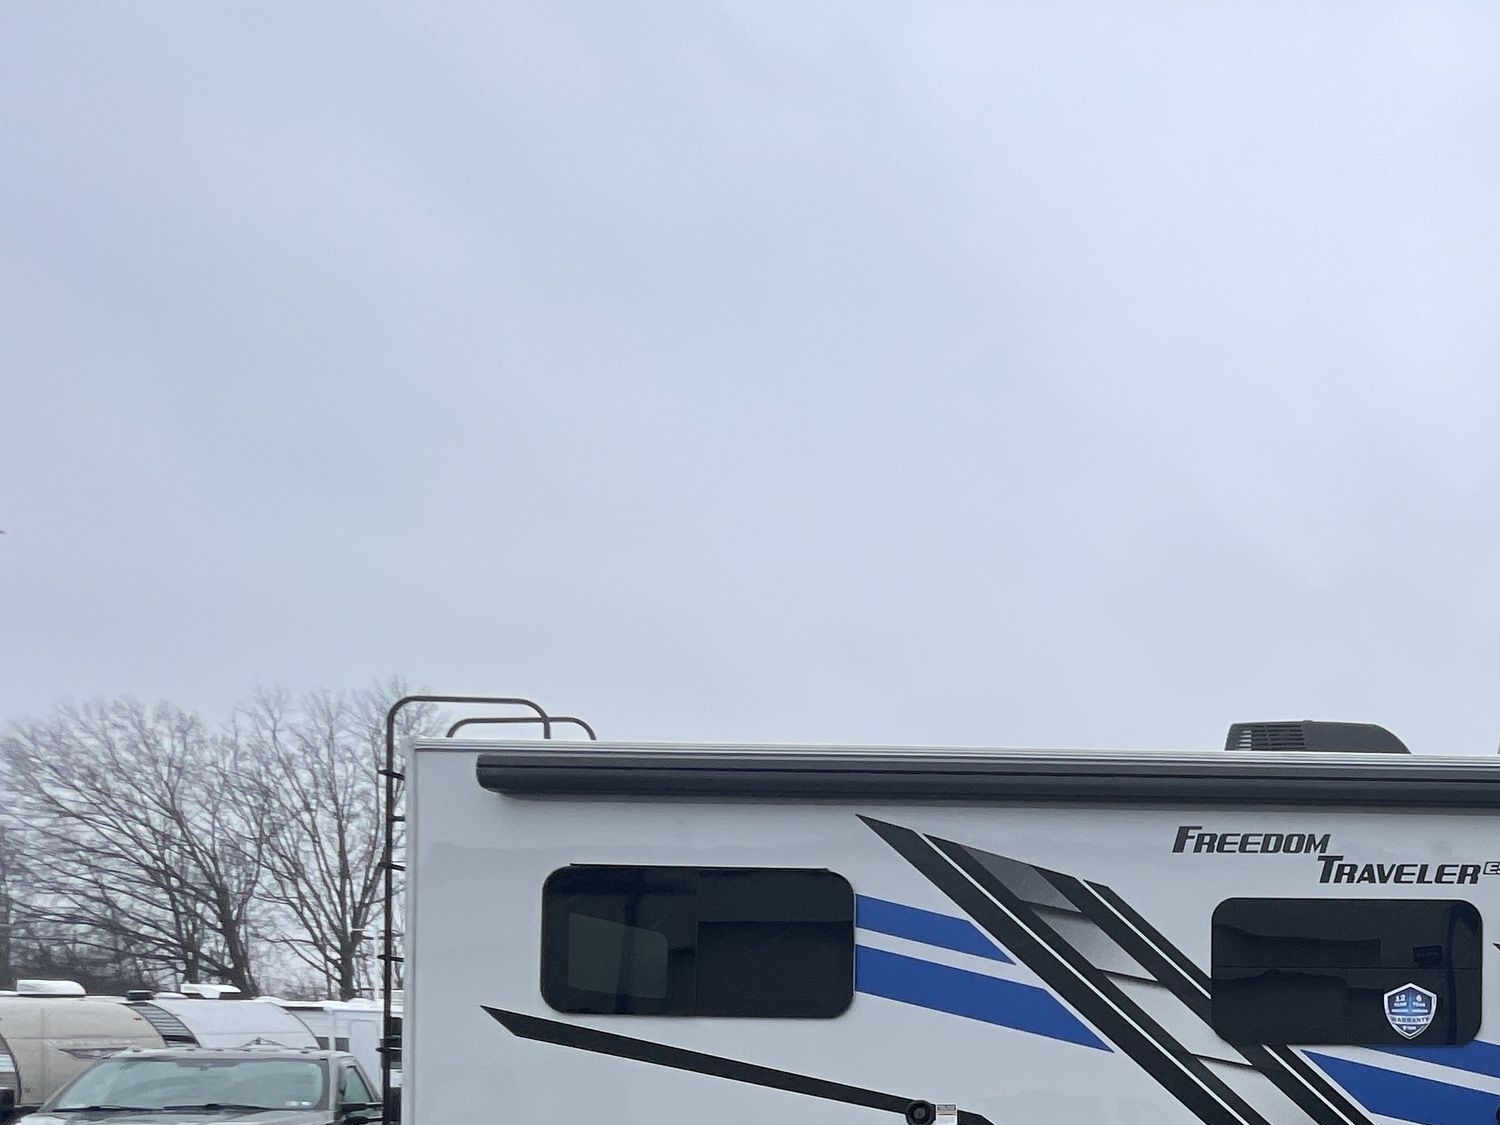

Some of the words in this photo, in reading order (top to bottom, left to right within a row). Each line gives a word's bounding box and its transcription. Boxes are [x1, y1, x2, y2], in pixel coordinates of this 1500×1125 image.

[1172, 826, 1330, 854] FREEDOM
[1317, 855, 1482, 885] TRAVELER
[1395, 994, 1406, 1002] 12
